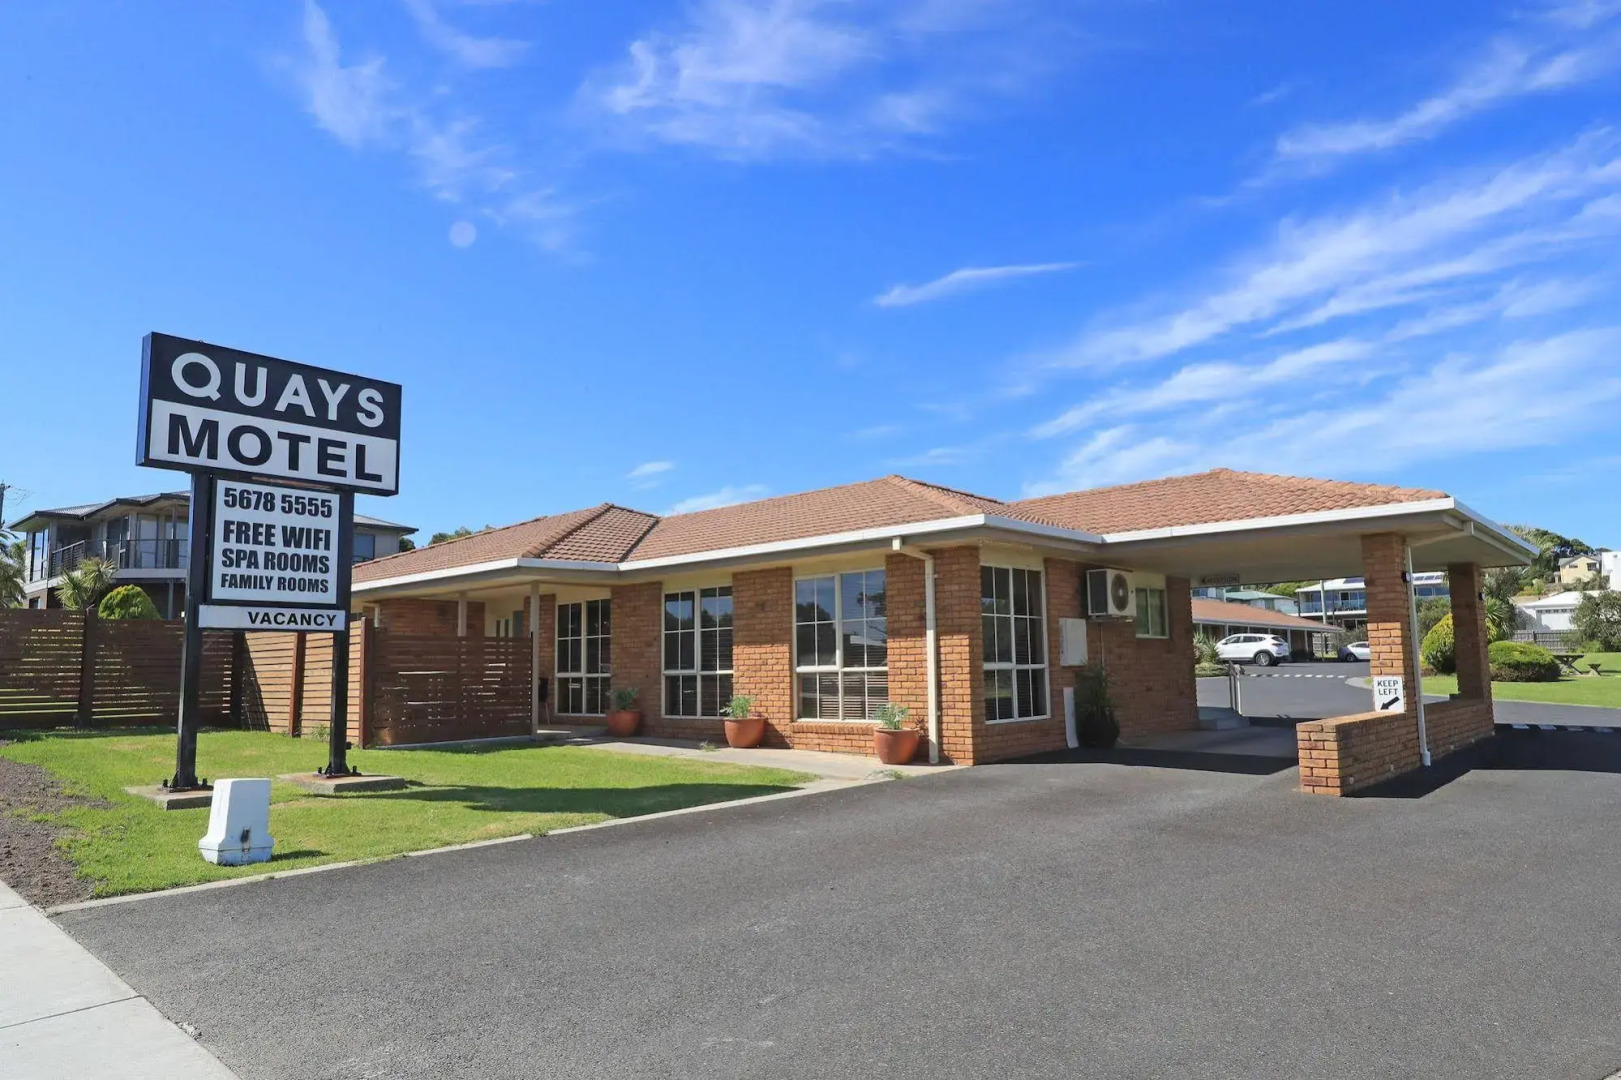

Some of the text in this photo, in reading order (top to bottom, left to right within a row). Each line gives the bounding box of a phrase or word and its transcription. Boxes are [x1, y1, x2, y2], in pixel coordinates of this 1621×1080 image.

[171, 352, 384, 428] QUAYS
[167, 413, 382, 483] MOTEL
[223, 487, 332, 518] 5678 5555
[223, 520, 331, 551] FREE WIFI
[221, 548, 330, 574] SPA ROOMS
[221, 573, 329, 593] FAMILY ROOMS
[247, 611, 337, 626] VACANCY
